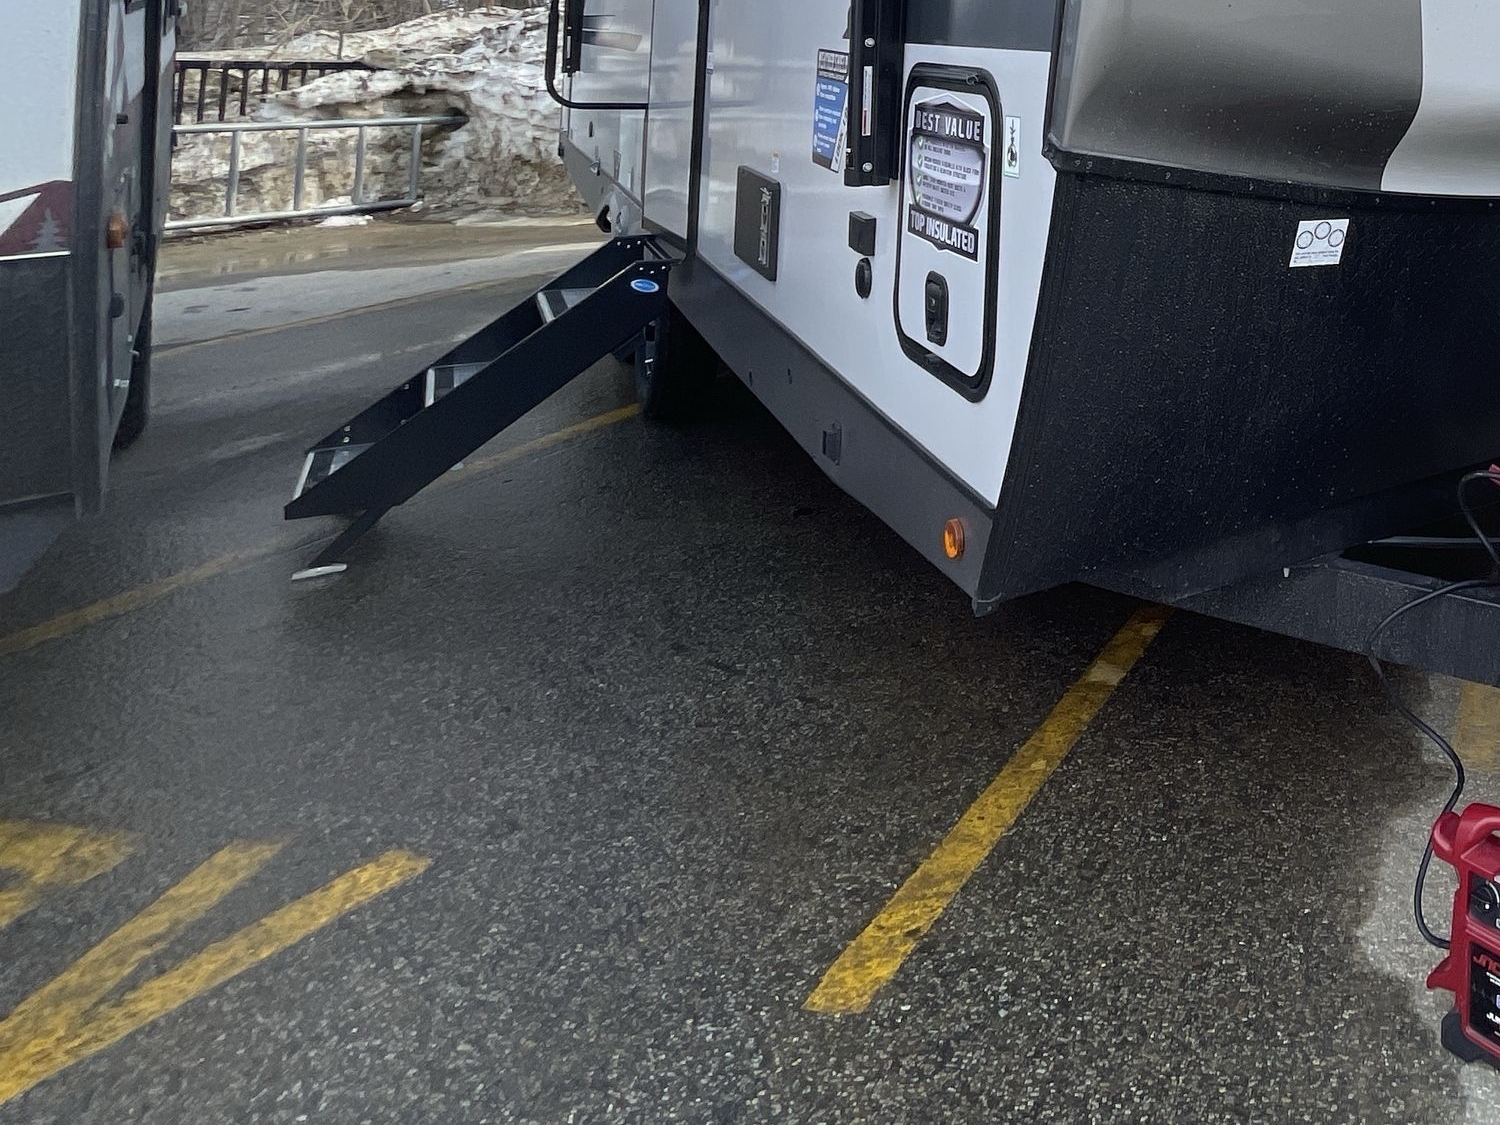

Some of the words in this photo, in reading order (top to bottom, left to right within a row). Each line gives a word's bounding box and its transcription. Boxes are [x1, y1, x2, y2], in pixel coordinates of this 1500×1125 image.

[915, 110, 941, 133] BEST
[944, 116, 981, 141] VALUE
[910, 209, 925, 232] TOP
[925, 216, 975, 254] INSULATED
